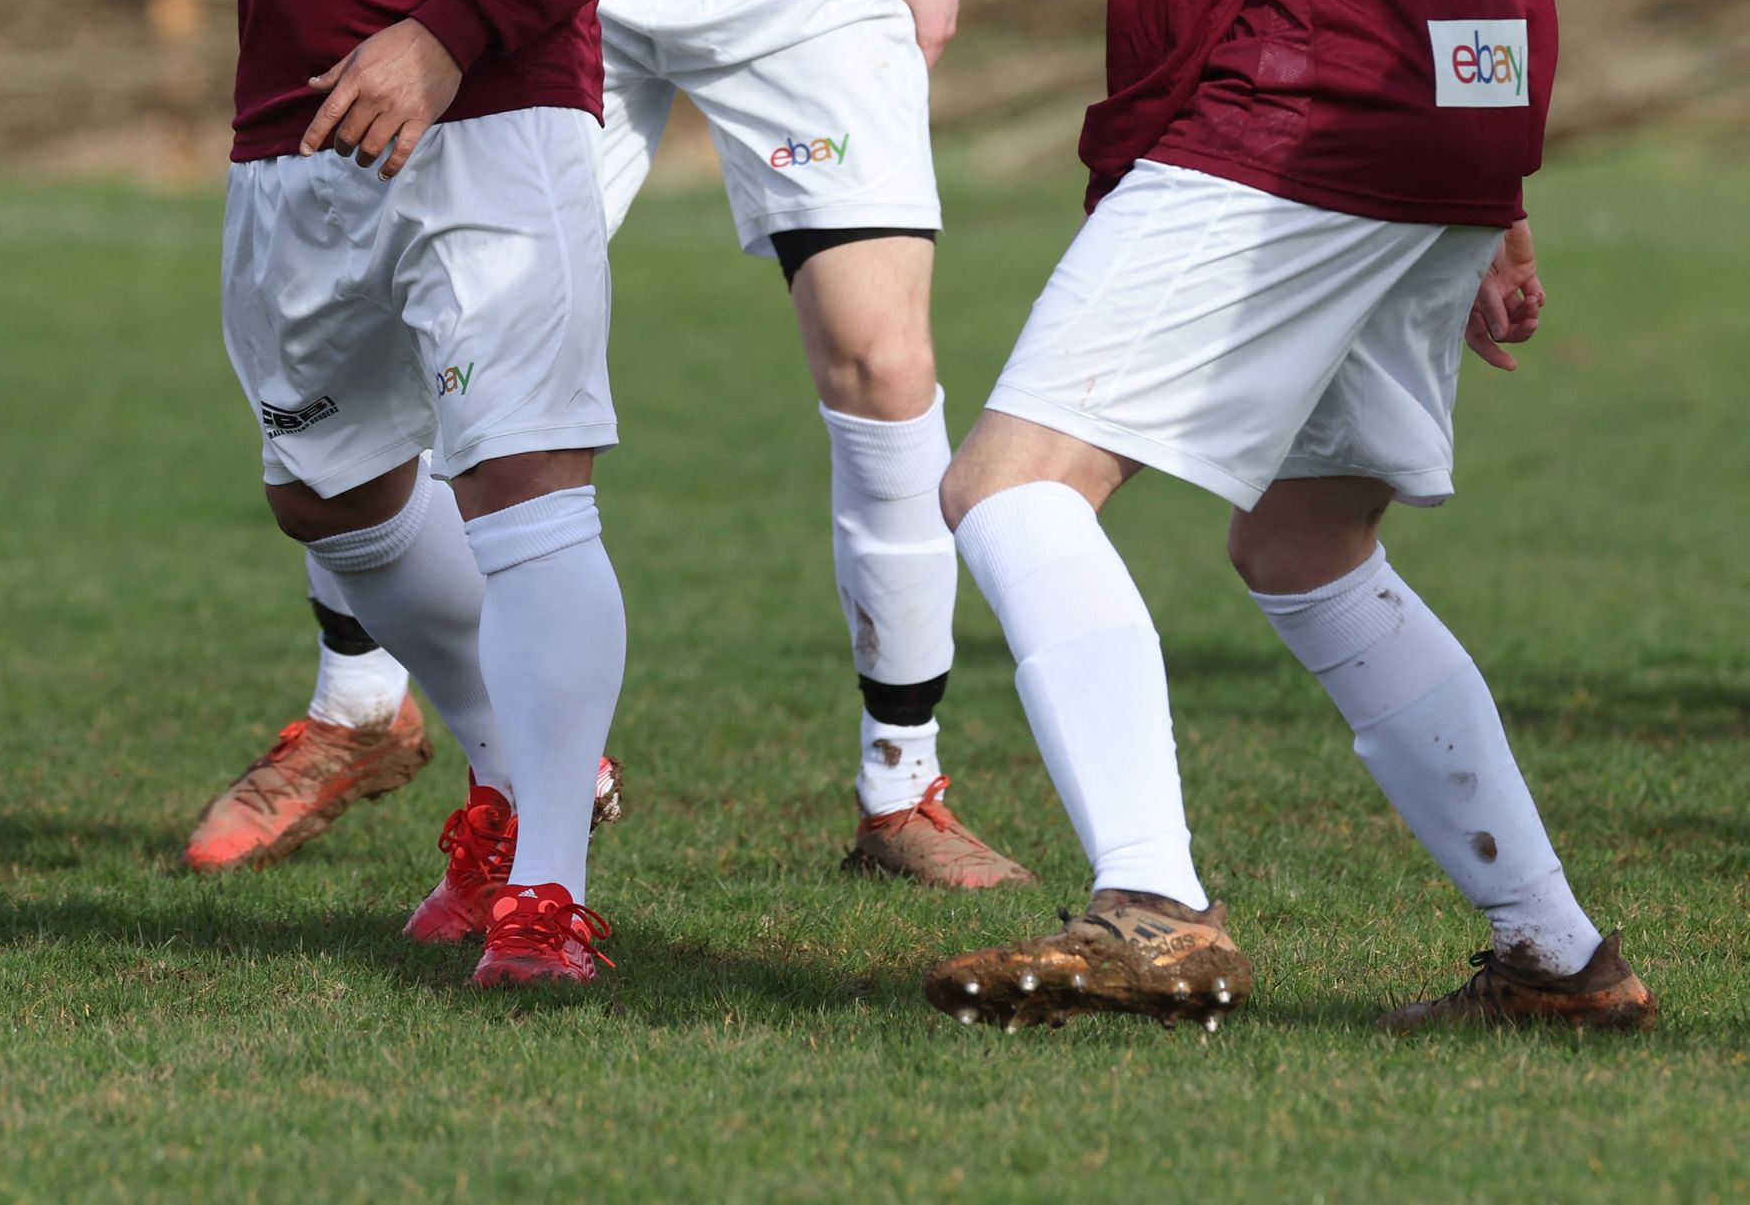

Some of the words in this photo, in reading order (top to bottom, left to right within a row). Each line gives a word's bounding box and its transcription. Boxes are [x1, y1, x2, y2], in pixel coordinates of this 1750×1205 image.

[1452, 29, 1523, 96] ebay
[771, 133, 850, 168] ebay
[436, 362, 474, 398] bay
